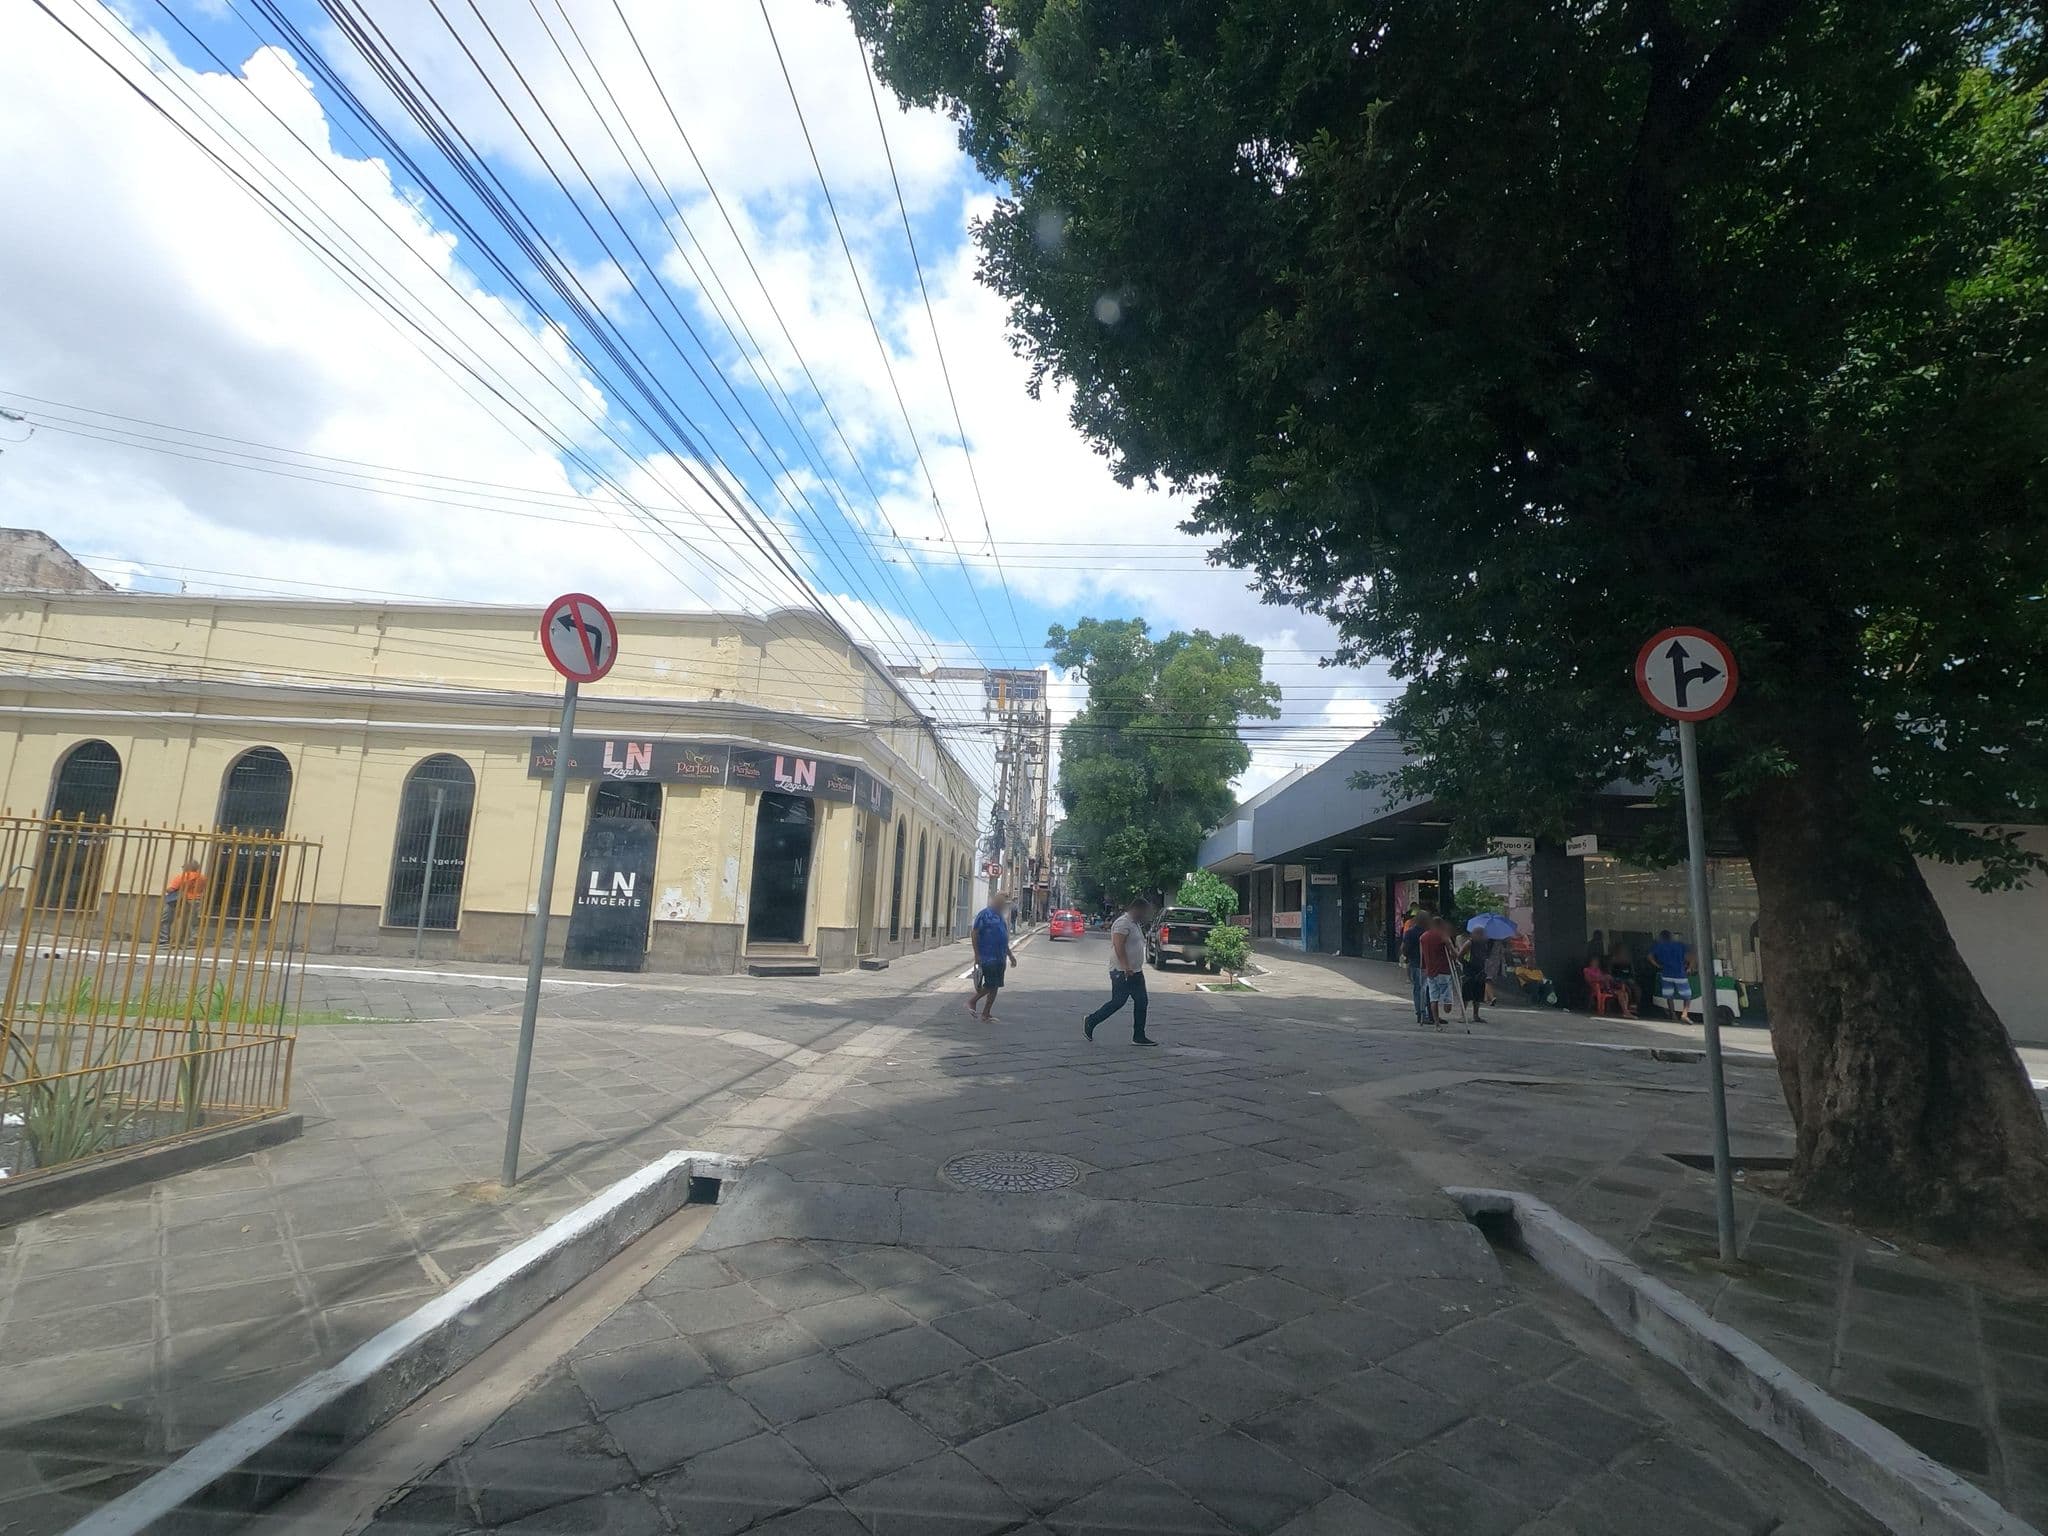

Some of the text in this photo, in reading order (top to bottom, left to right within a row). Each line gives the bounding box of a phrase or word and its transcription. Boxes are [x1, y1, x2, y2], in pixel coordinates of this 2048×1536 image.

[603, 741, 653, 770] LN
[603, 767, 649, 780] Lingerie
[676, 762, 719, 775] Perfeita
[774, 755, 817, 786] LN
[775, 779, 814, 793] Lingerie
[588, 870, 636, 897] LN
[577, 897, 641, 907] LINGERIE
